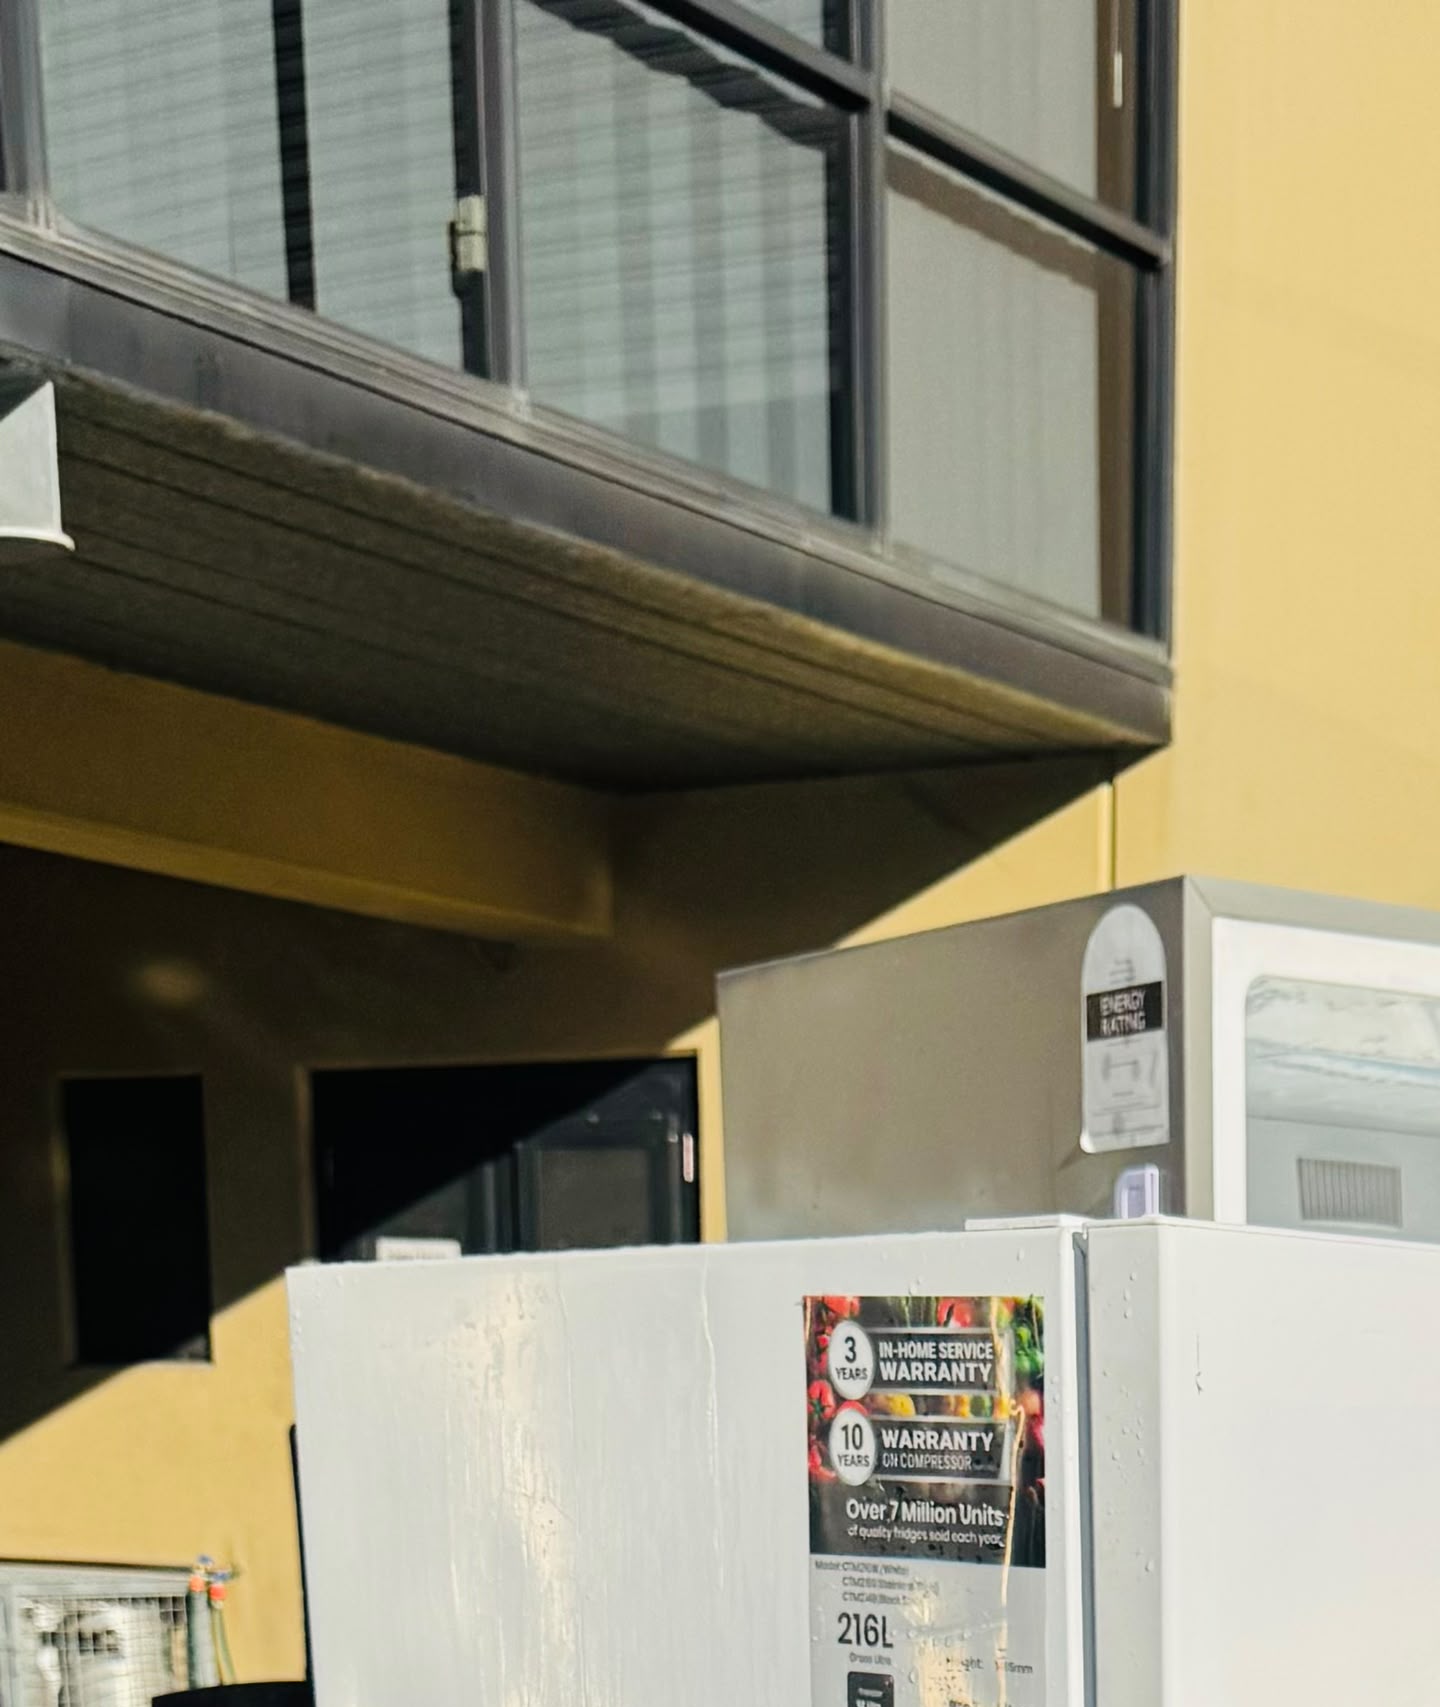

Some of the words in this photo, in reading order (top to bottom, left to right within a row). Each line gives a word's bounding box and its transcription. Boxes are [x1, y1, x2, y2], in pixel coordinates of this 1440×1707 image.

[1100, 989, 1146, 1016] ENERGY
[1102, 1010, 1146, 1035] RATING
[844, 1336, 857, 1363] 3
[879, 1341, 937, 1359] IN-HOME
[938, 1342, 993, 1360] SERVICE
[835, 1367, 868, 1380] YEARS
[879, 1361, 992, 1382] WARRANTY
[841, 1423, 863, 1450] 10
[881, 1428, 994, 1452] WARRANTY
[837, 1454, 870, 1468] YEARS
[882, 1452, 898, 1468] ON
[899, 1452, 972, 1470] COMPRESSOR
[846, 1498, 887, 1521] Over
[889, 1500, 899, 1521] 7
[901, 1501, 957, 1524] Million
[958, 1502, 1005, 1527] Units
[859, 1525, 892, 1542] quality
[893, 1525, 928, 1544] fridges
[929, 1529, 949, 1542] sold
[951, 1531, 977, 1543] each
[837, 1611, 894, 1648] 216L
